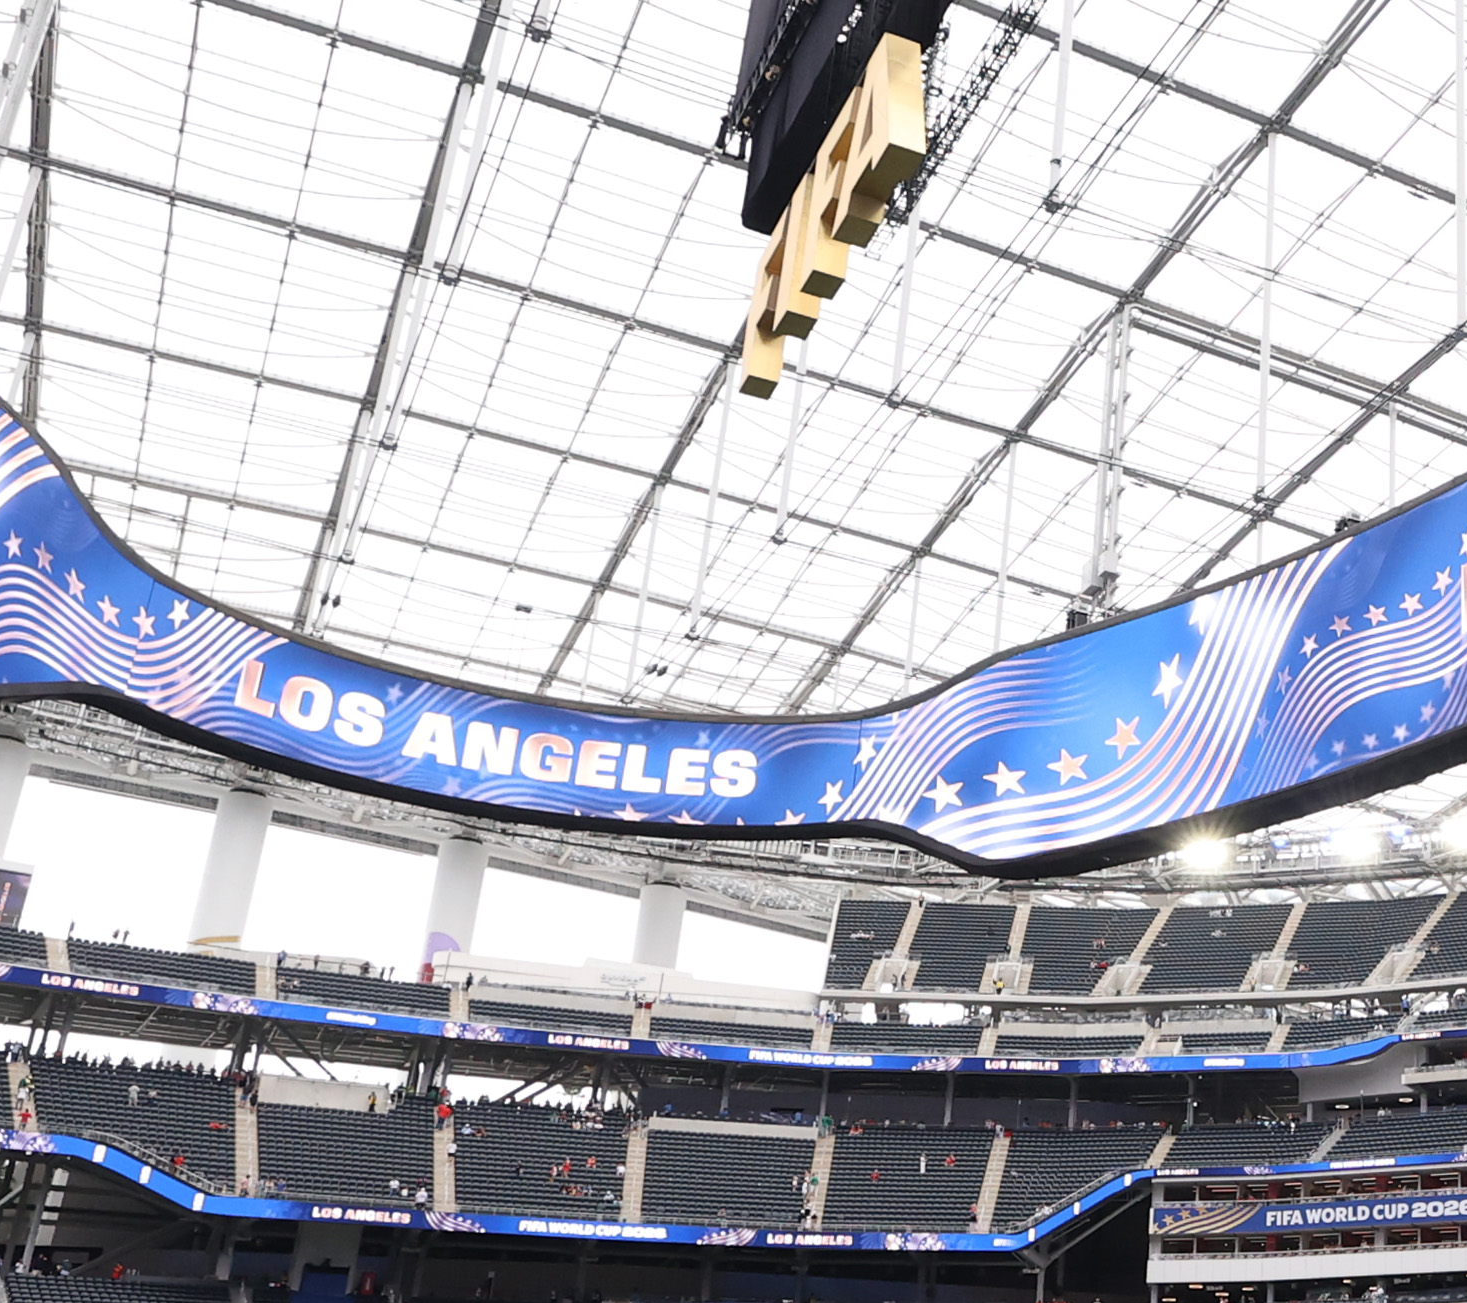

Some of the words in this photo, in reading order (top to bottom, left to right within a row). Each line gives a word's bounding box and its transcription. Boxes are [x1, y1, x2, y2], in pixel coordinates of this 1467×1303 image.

[231, 657, 385, 747] LOS
[402, 711, 758, 800] ANGELES
[40, 974, 72, 988] LOS
[72, 978, 140, 997] ANGELES
[574, 1036, 630, 1051] ANGELES
[1008, 1060, 1059, 1071] ANGELES
[311, 1206, 343, 1220] LOS
[343, 1208, 411, 1224] ANGELES
[1266, 1209, 1304, 1227] FIFA
[1305, 1205, 1371, 1224] WORLD
[1372, 1202, 1410, 1221] CUP
[518, 1220, 549, 1233] FIFA
[547, 1222, 596, 1236] WORLD
[594, 1224, 624, 1237] CUP
[794, 1234, 853, 1246] ANGELES
